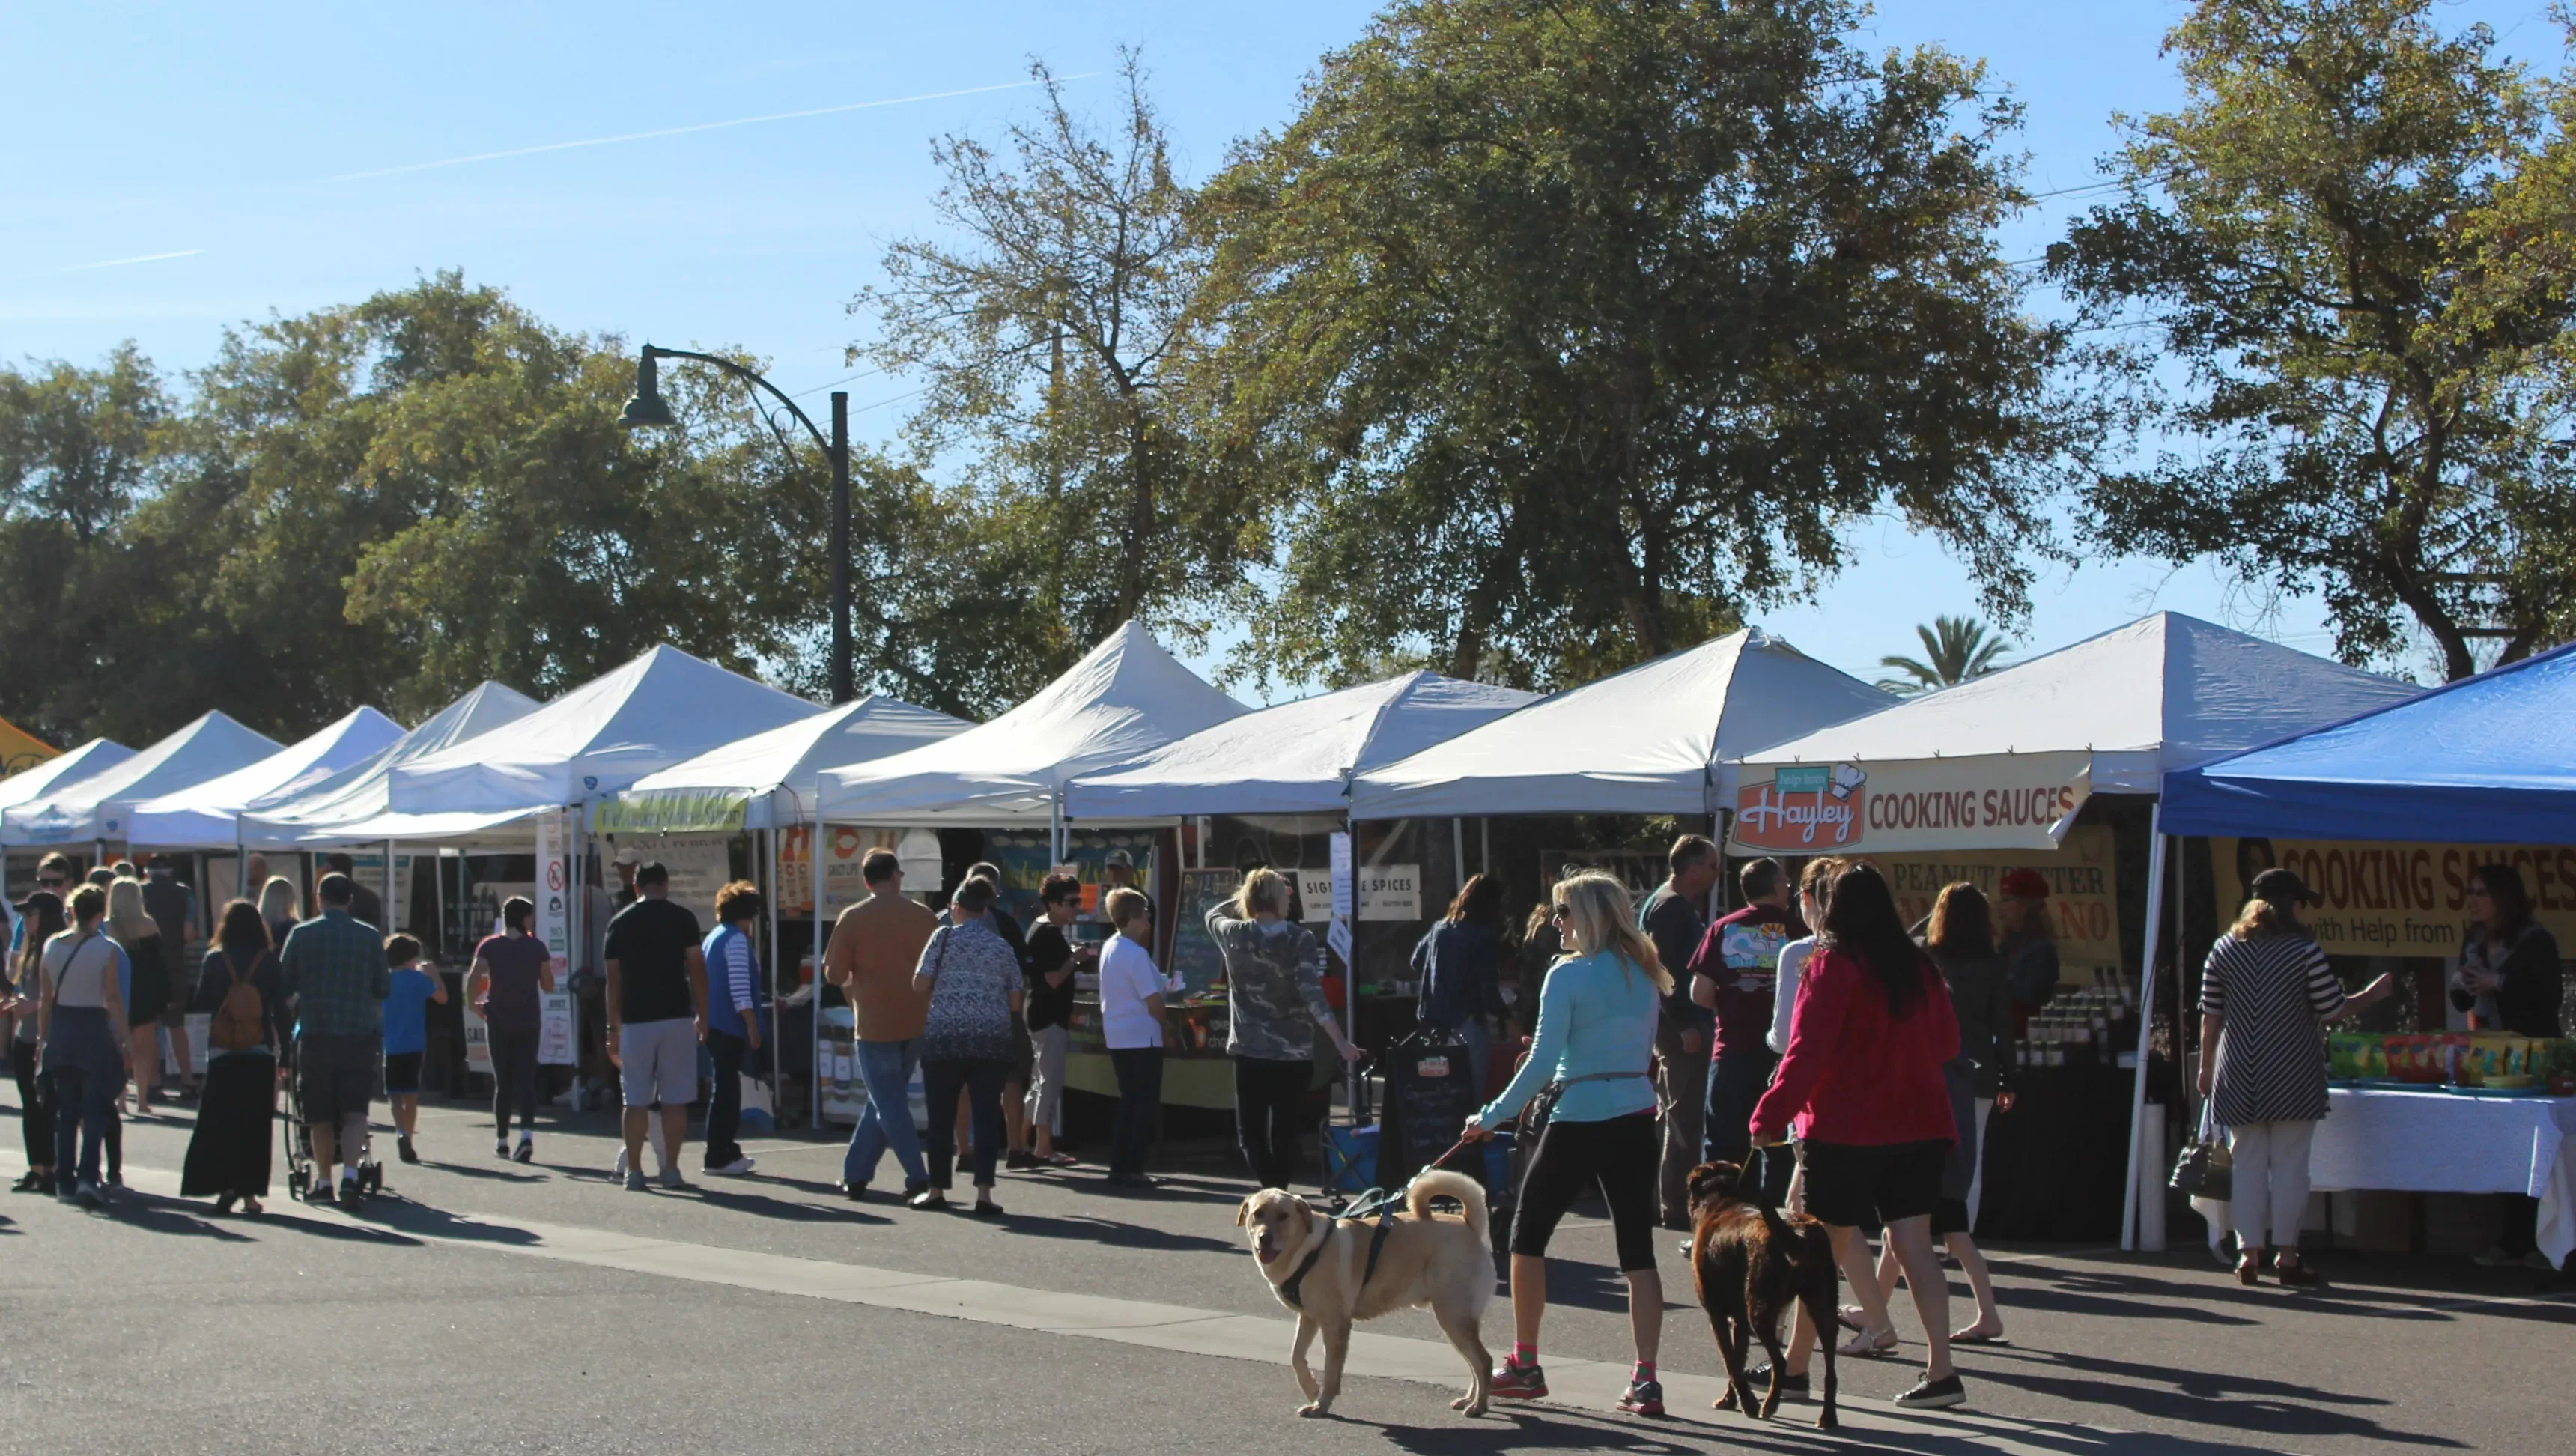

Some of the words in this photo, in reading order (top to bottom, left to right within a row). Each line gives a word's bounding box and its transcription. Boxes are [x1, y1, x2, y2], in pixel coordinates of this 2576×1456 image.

[1779, 774, 1802, 788] help
[1740, 786, 1857, 843] Hayley
[1869, 790, 1976, 830] COOKING
[1983, 786, 2075, 827] SAUCES
[1372, 878, 1412, 891] SPICES
[1893, 864, 1995, 892] PEANUT
[2443, 849, 2576, 911] SACES
[2350, 917, 2398, 949] Help
[2403, 917, 2455, 943] from
